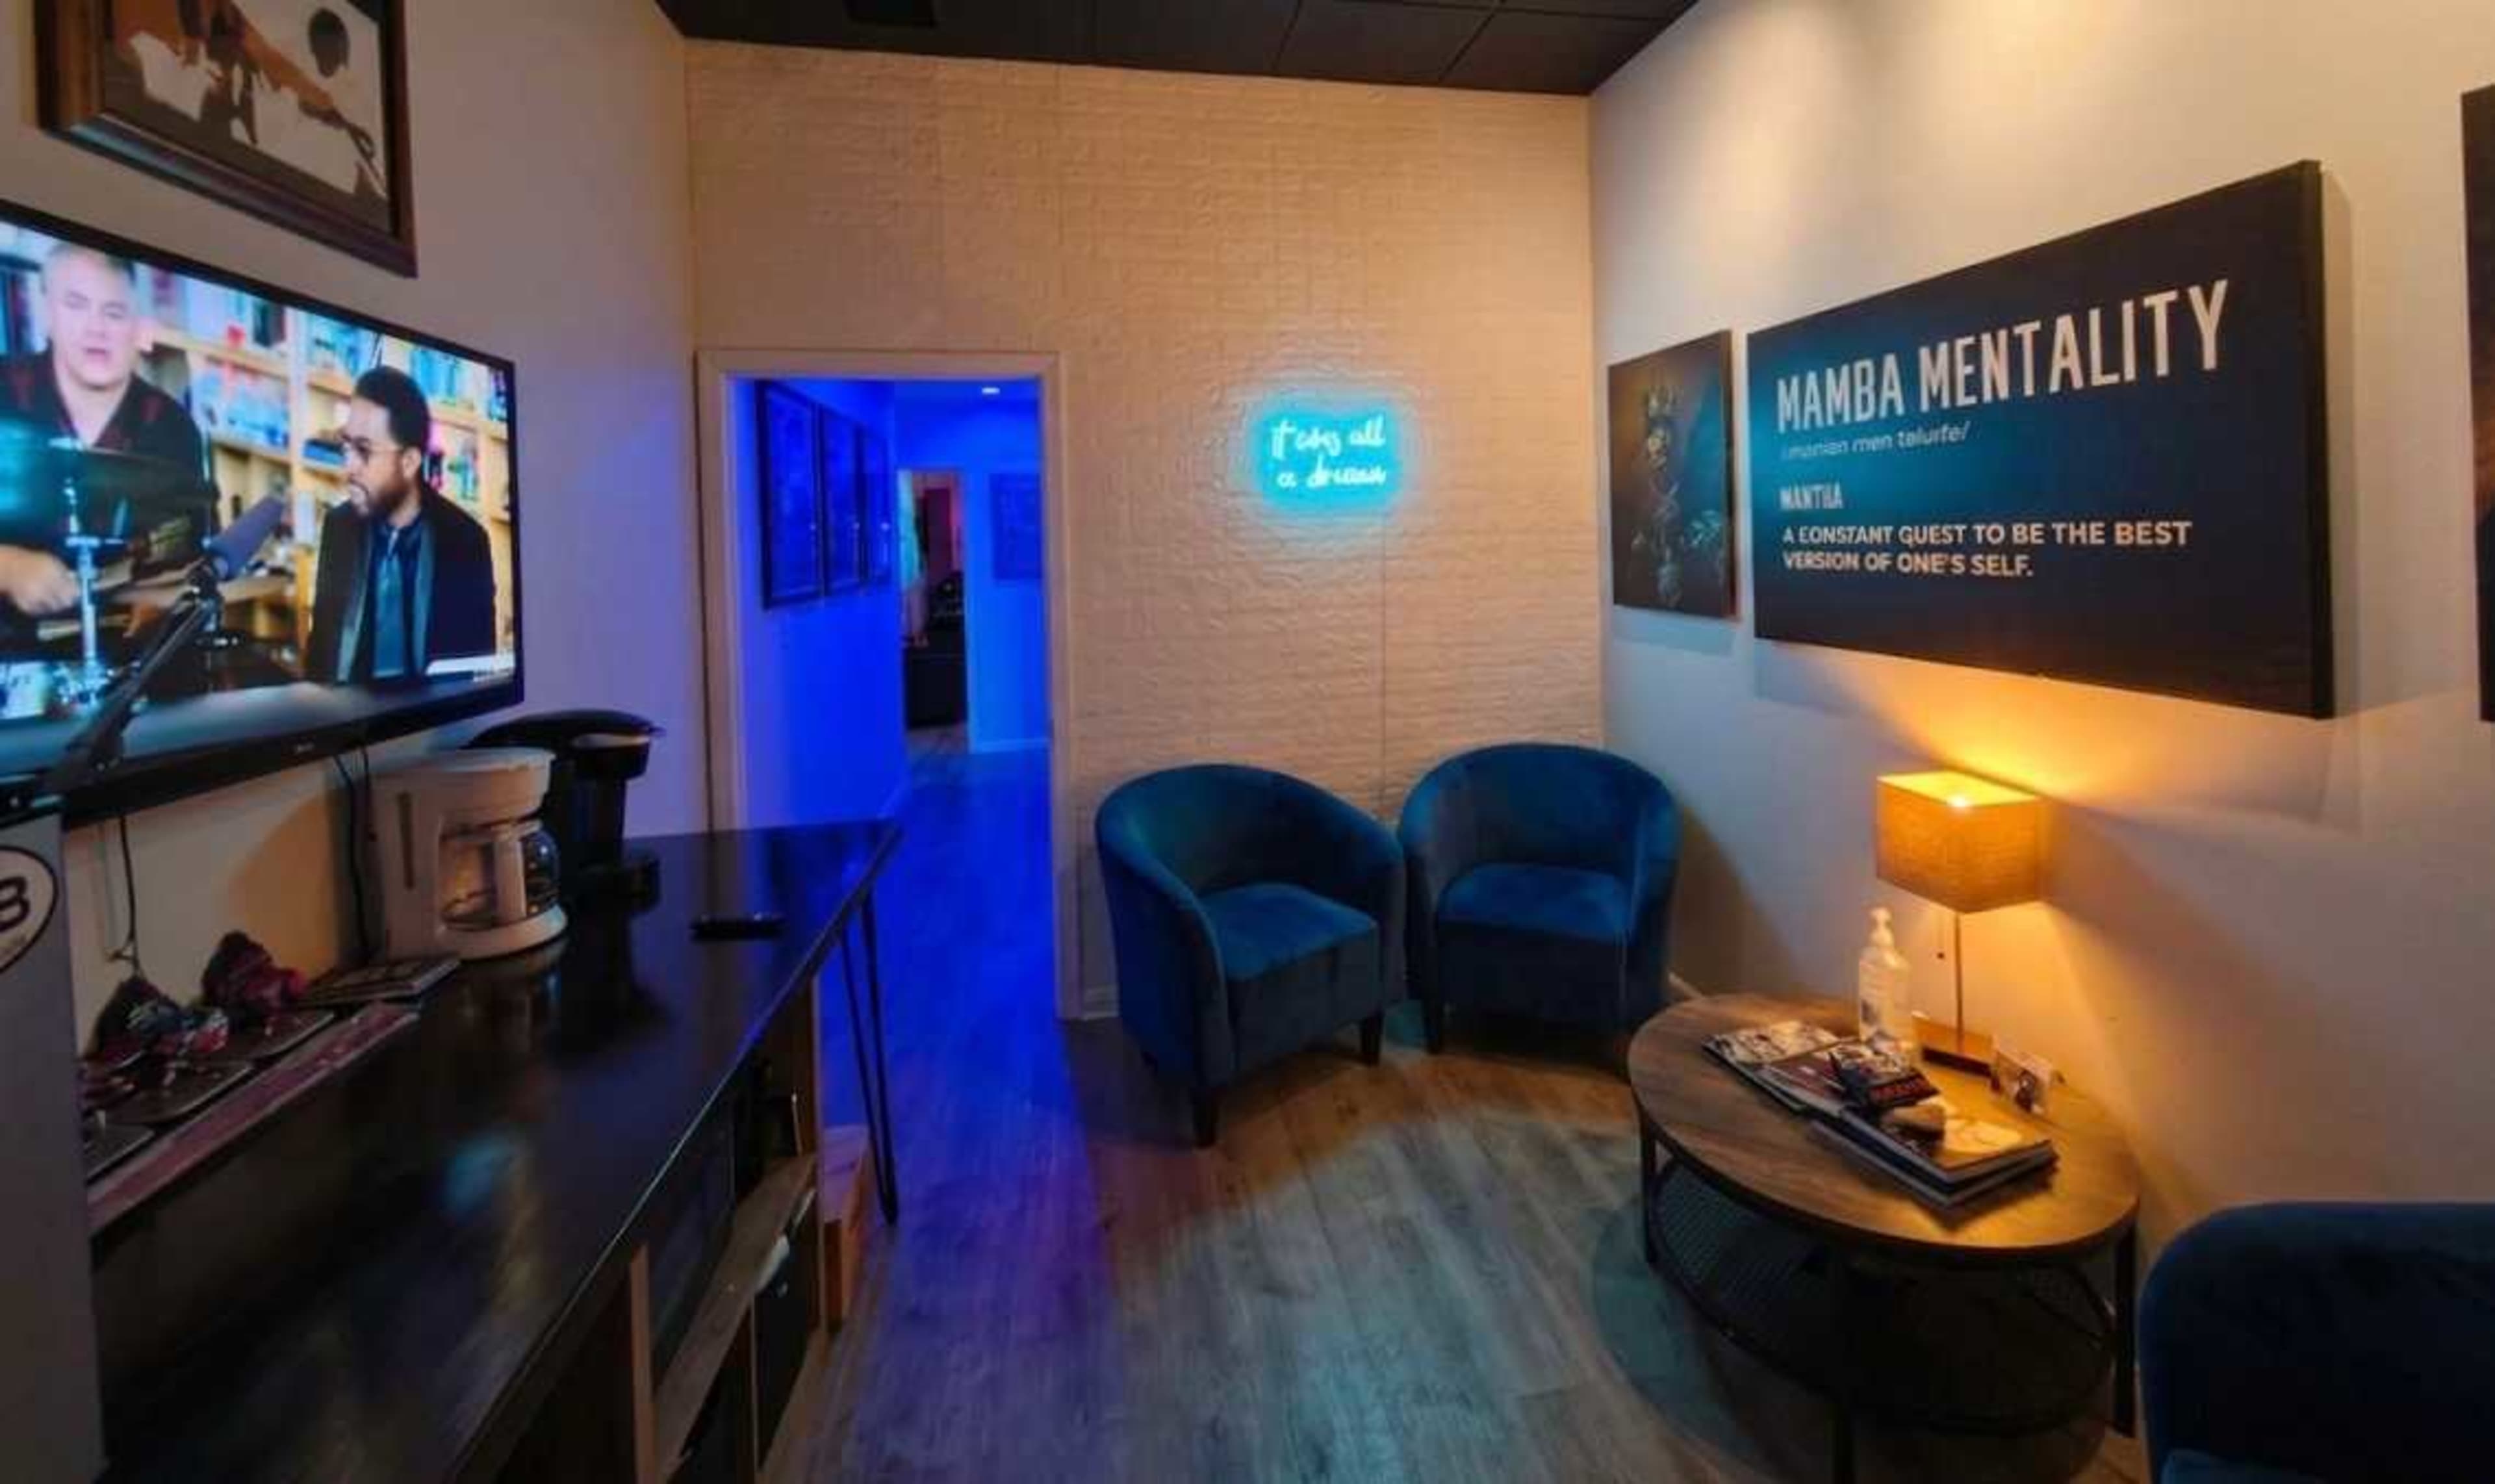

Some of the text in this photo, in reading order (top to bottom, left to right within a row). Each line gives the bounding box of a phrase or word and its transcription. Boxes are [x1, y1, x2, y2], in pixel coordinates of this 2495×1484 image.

[1777, 279, 2229, 433] MAMBA MENTALITY
[1782, 525, 1795, 544] A
[1971, 524, 2005, 544] TO
[2012, 523, 2045, 545] BE
[2052, 522, 2106, 545] THE
[2115, 521, 2193, 546] BEST
[1783, 550, 2034, 578] VERSION OF ONE'S SELF.
